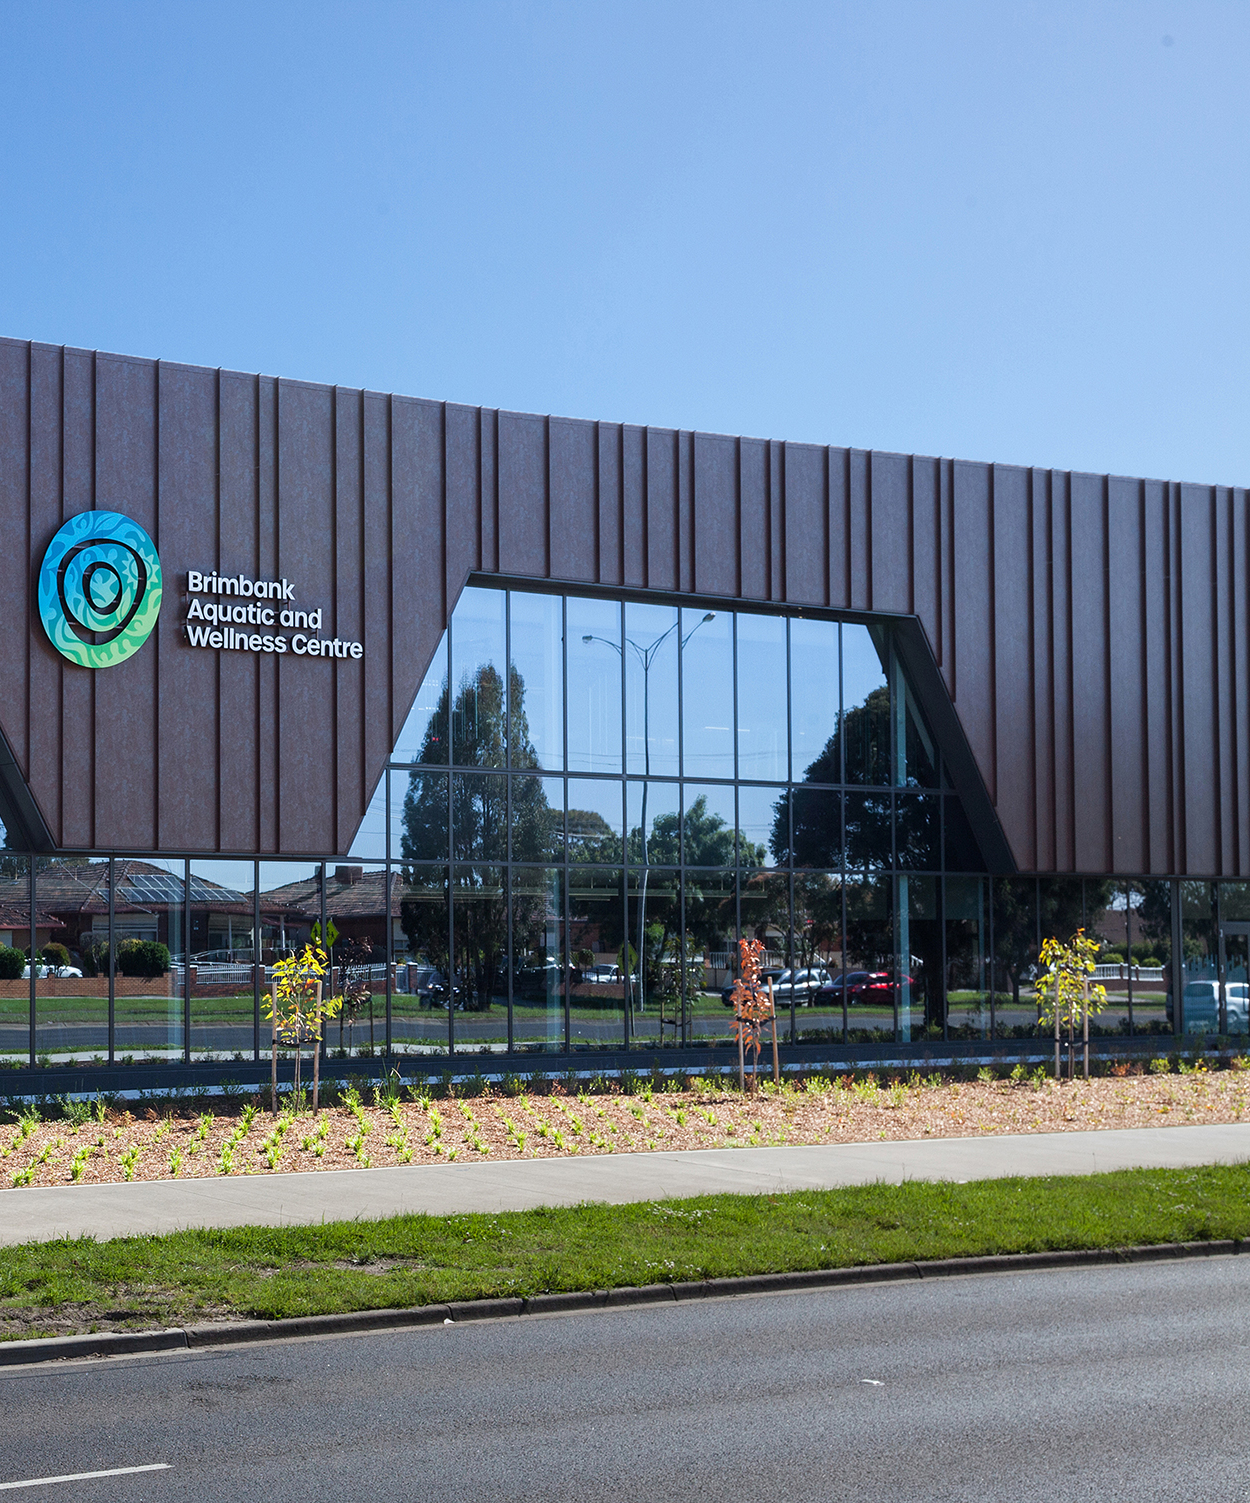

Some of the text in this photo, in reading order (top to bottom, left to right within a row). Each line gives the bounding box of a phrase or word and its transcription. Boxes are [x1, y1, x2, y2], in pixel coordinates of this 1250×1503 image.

[188, 571, 296, 601] Brimbank
[187, 598, 322, 630] Aquatic and
[187, 625, 363, 659] Wellness Centre
